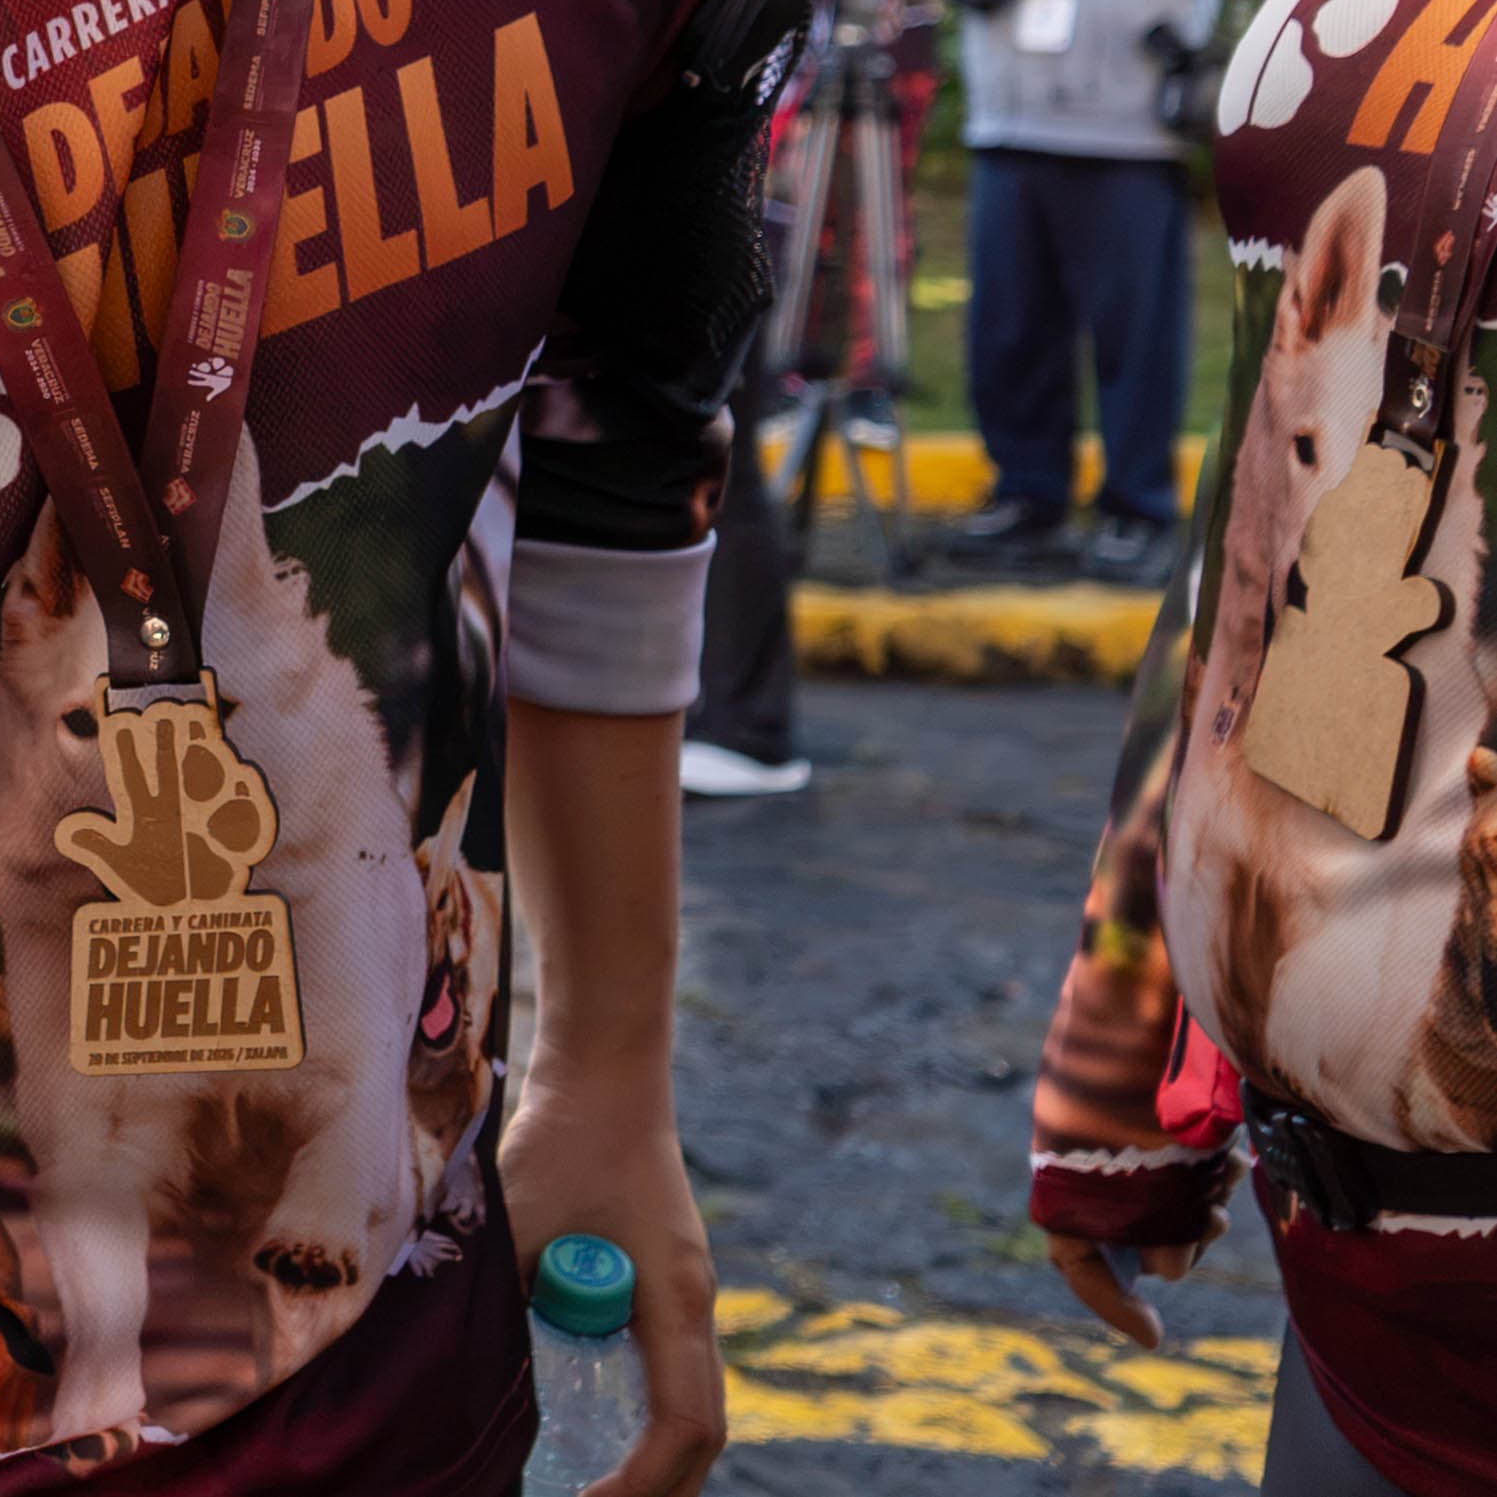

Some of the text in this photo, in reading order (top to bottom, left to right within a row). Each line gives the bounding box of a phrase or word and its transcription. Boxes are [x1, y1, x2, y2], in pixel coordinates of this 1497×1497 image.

[243, 55, 262, 110] SEDEMA
[234, 129, 255, 199] VERACRUZ
[195, 281, 222, 351] DEJANDO
[212, 268, 254, 360] HUELLA
[31, 338, 65, 405] VERACRUZ
[71, 417, 100, 471] SEDEMA
[98, 487, 132, 549] SEFIPLAN
[87, 929, 276, 979] DEJANDO
[89, 911, 273, 934] CARRERA Y CAMINATA
[85, 975, 286, 1042] HUELLA
